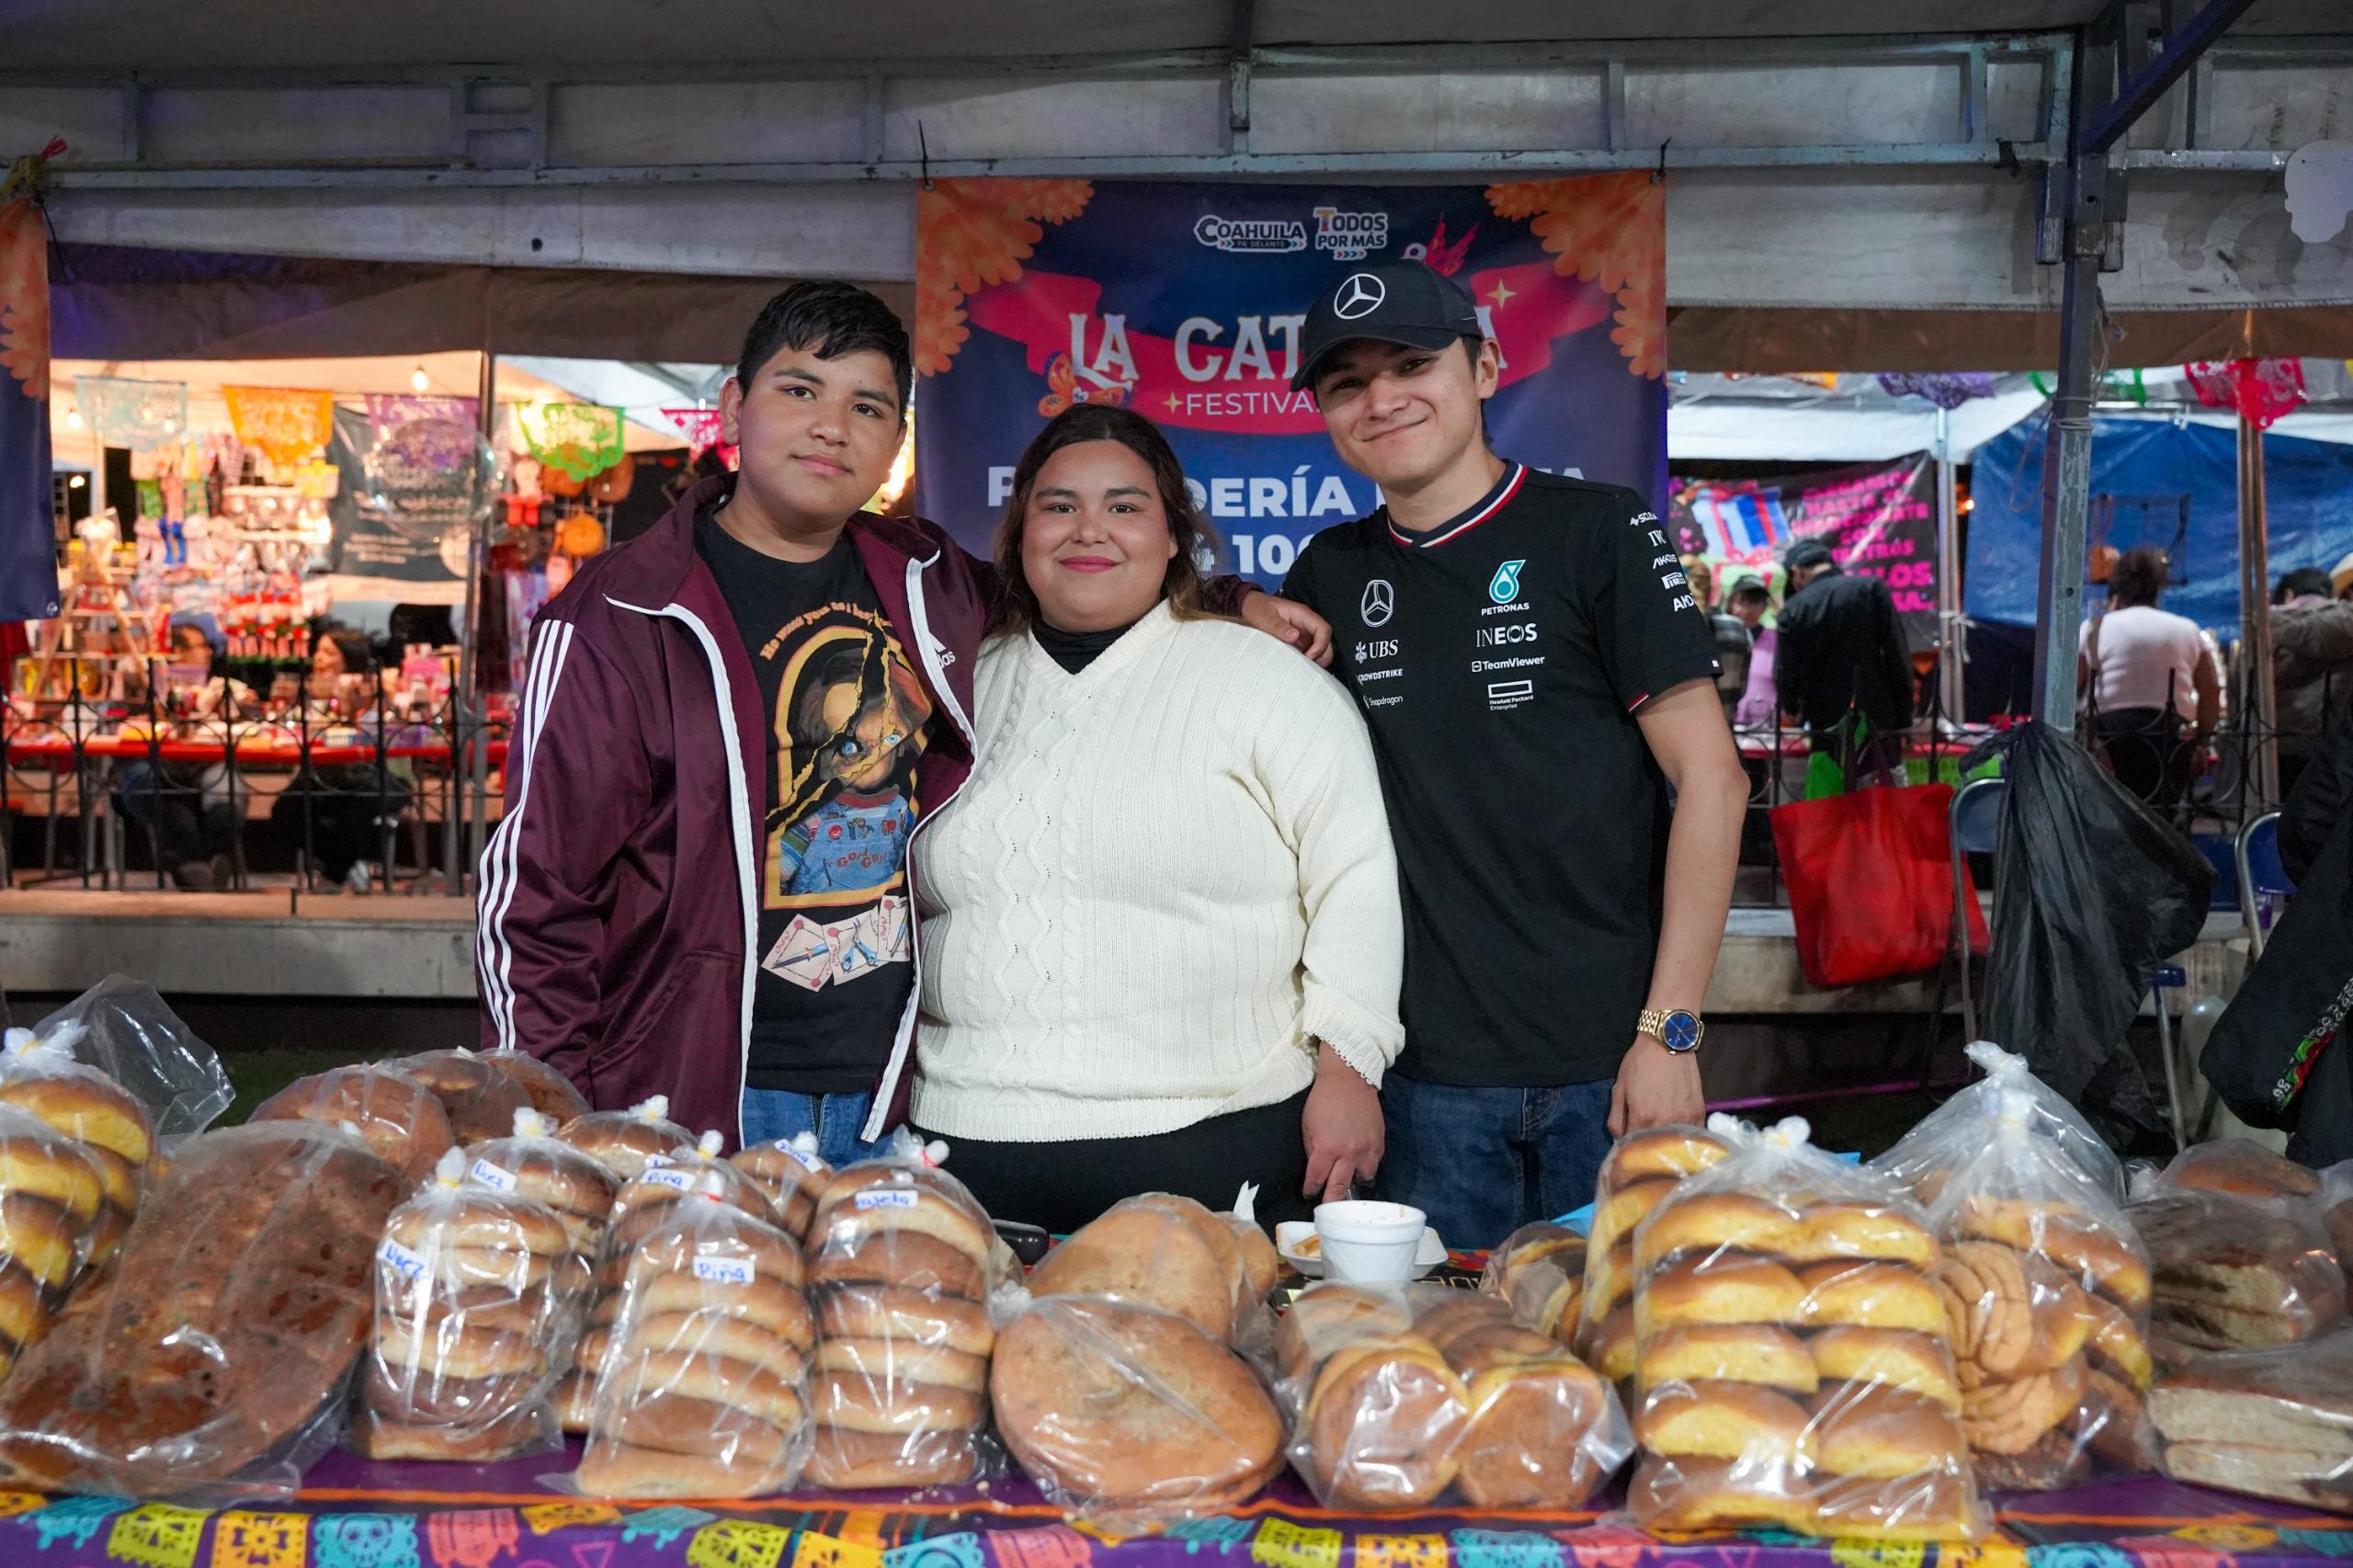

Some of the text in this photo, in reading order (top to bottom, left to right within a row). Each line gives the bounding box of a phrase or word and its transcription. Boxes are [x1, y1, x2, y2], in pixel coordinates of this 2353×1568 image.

[1195, 216, 1305, 243] COAHUILA
[1315, 209, 1386, 232] TODOS
[1317, 232, 1385, 247] POR MÁS
[1069, 312, 1141, 391] LA
[1187, 392, 1321, 415] FESTIVA
[1481, 602, 1530, 616] PETRONAS
[1475, 622, 1538, 647] INEOS
[1369, 639, 1399, 659] UBS
[1483, 655, 1545, 671] TeamViewer
[1358, 668, 1404, 682] CROWDSTRIKE
[1369, 695, 1404, 707] Snapdragon
[699, 1263, 745, 1283] Piña
